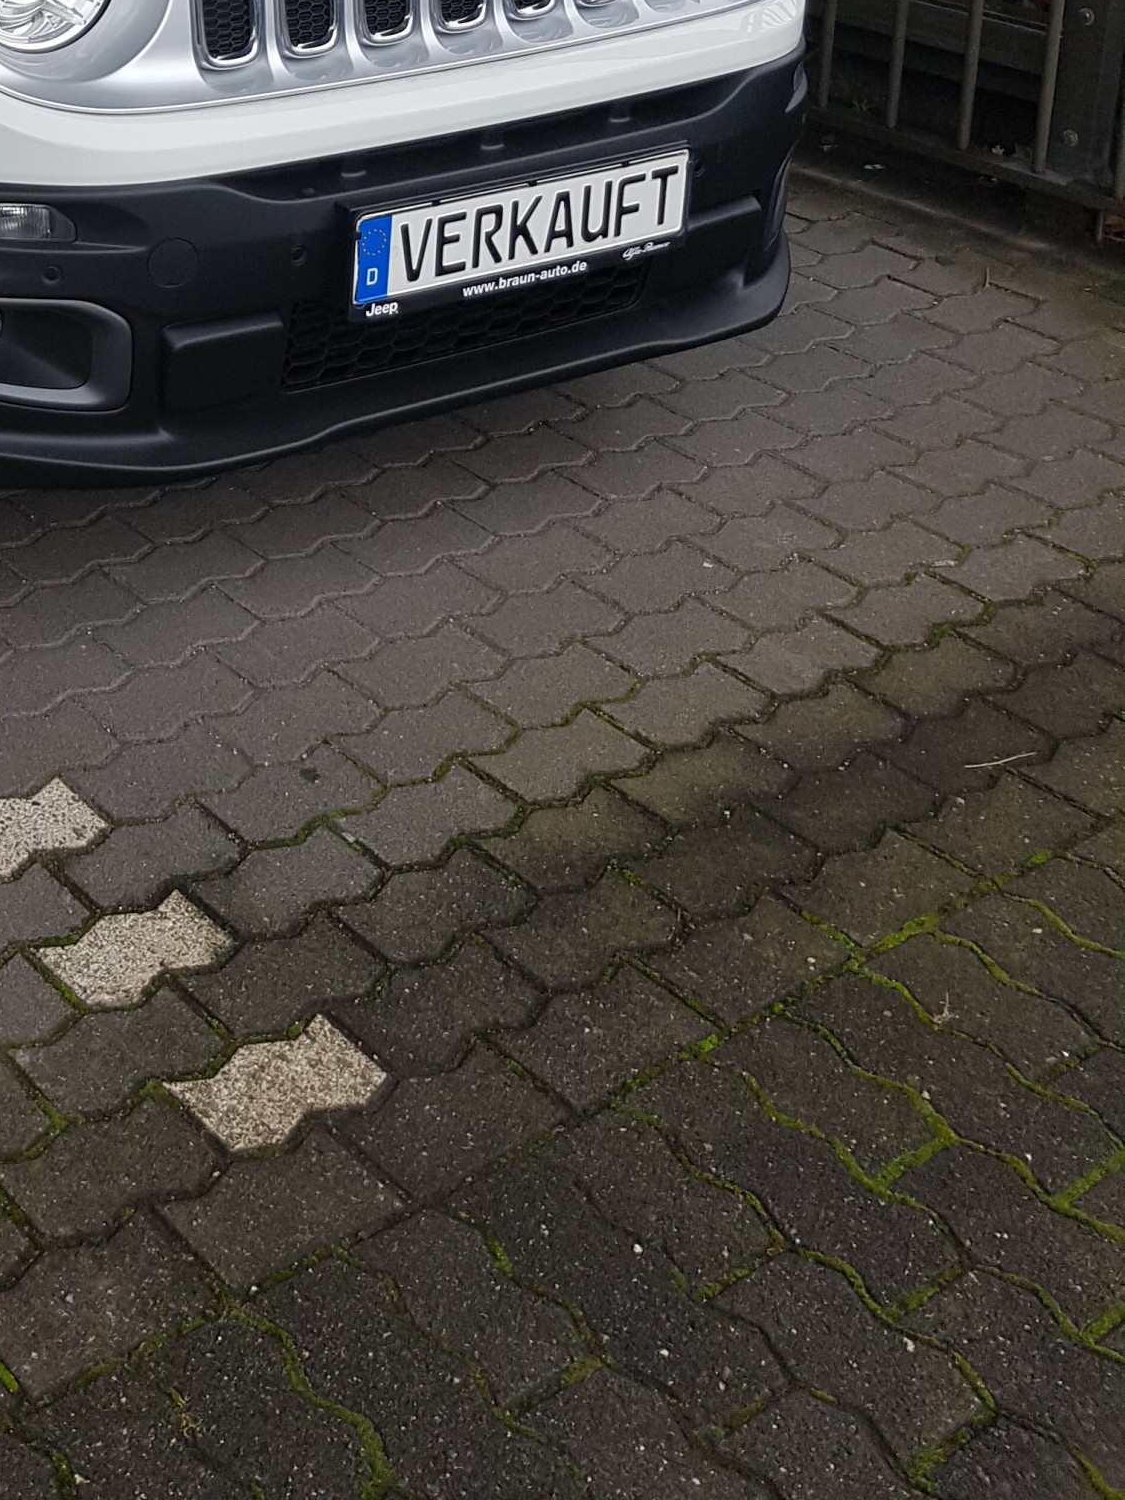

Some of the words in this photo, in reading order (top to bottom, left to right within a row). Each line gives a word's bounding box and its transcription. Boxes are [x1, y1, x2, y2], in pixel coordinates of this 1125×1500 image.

[400, 164, 680, 283] VERKAUFT
[365, 302, 398, 317] Jeep
[462, 260, 587, 298] www.braun-auto.de
[366, 267, 378, 286] D
